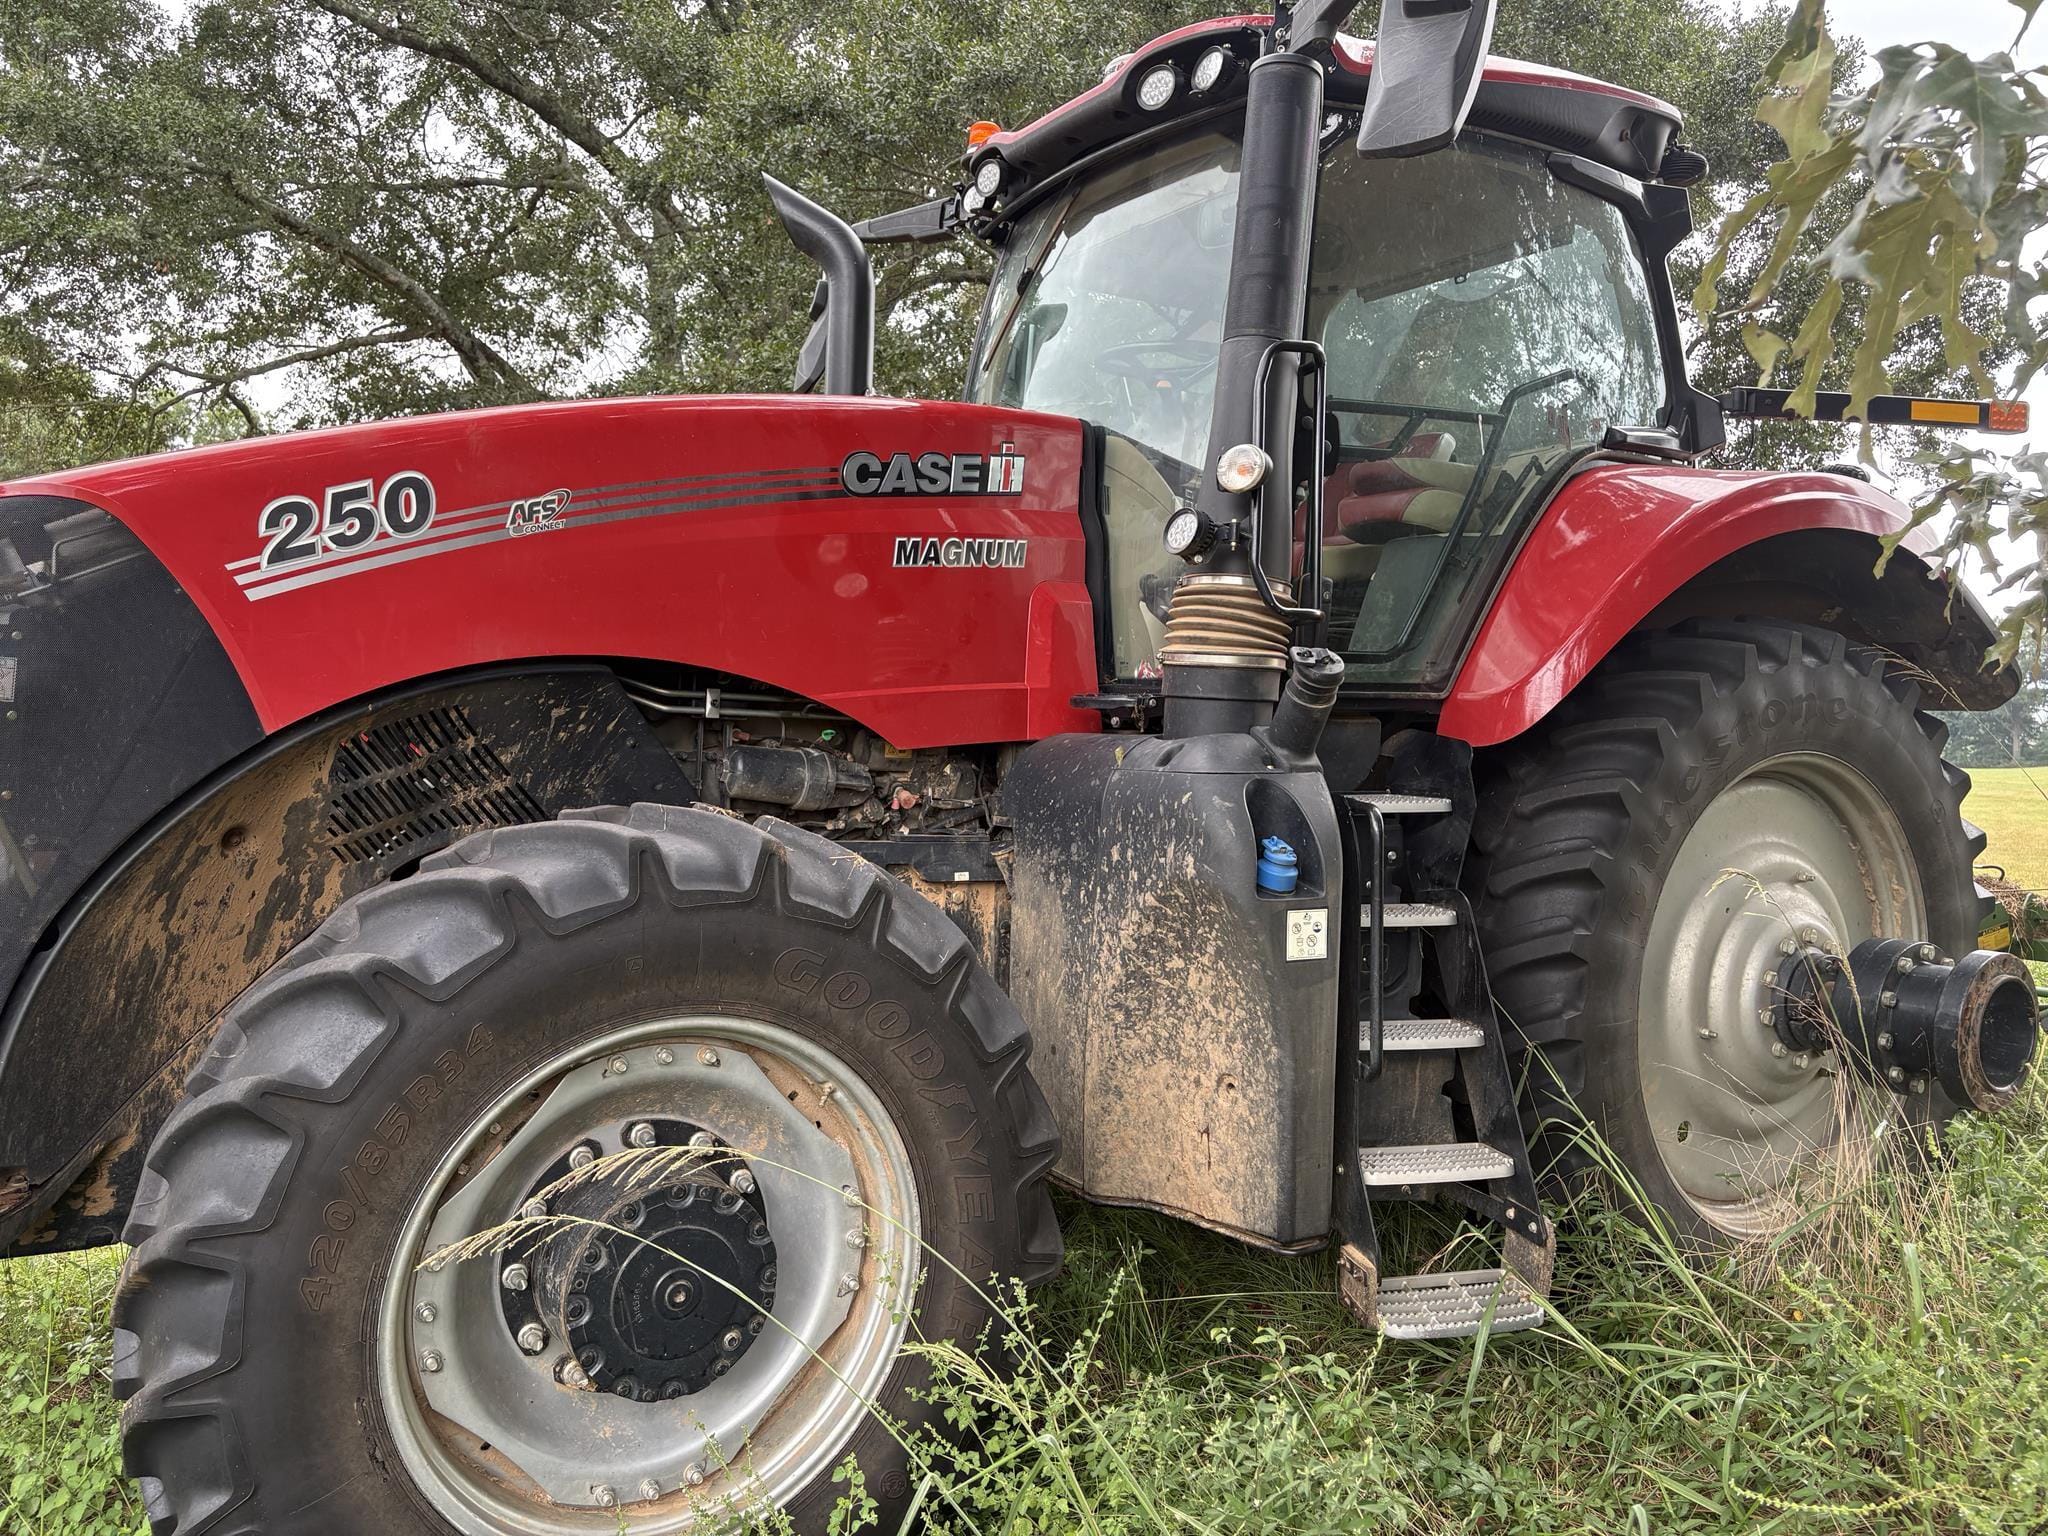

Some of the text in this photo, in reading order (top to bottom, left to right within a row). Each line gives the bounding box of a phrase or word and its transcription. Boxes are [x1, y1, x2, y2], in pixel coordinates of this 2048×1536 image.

[842, 451, 982, 495] CASE
[258, 470, 437, 572] 250
[506, 494, 560, 528] AFS
[524, 519, 566, 534] CONNECT
[893, 536, 1028, 568] MAGNUM
[300, 1022, 496, 1312] 420/85R34
